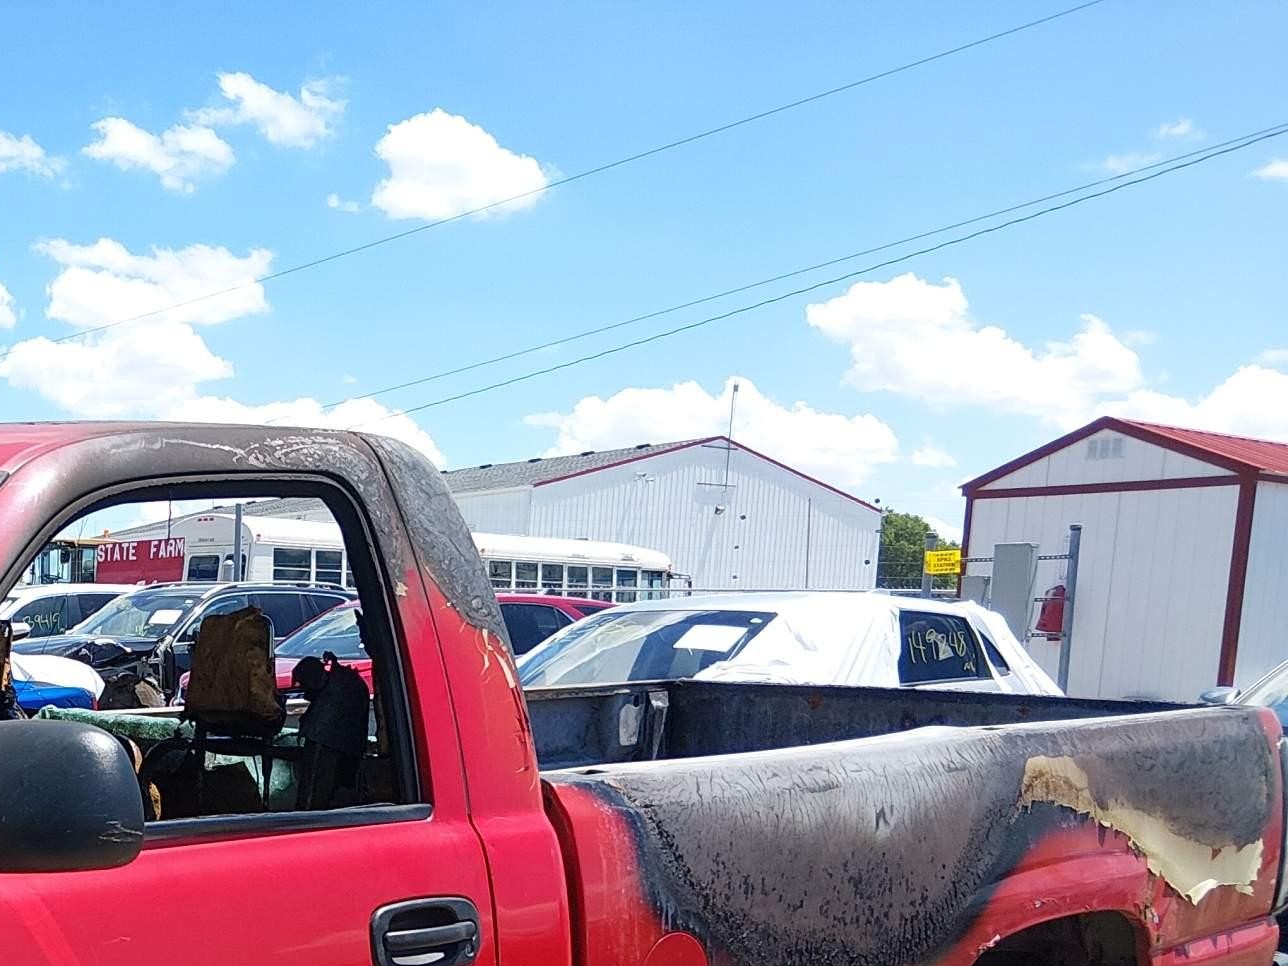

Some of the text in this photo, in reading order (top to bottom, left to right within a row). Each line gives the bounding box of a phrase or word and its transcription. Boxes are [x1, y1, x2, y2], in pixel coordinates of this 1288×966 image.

[97, 539, 184, 562] STATE FARM
[908, 628, 967, 665] 149248
